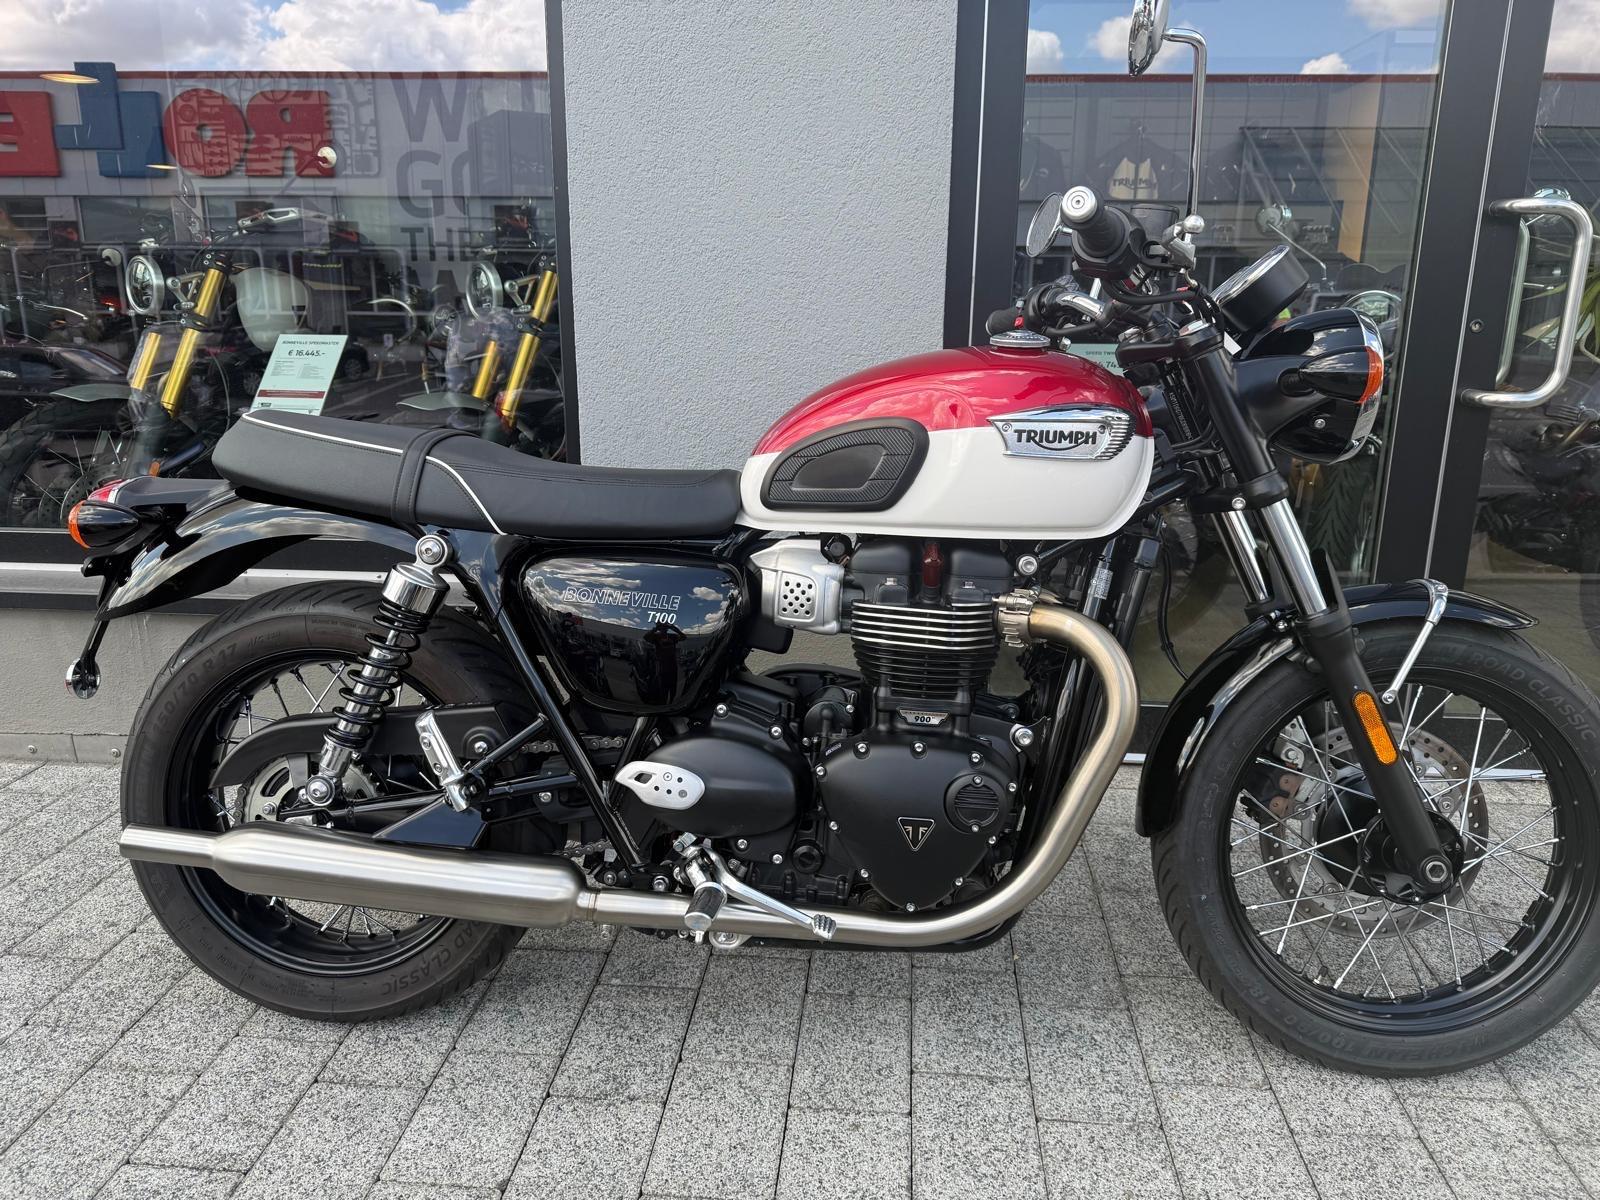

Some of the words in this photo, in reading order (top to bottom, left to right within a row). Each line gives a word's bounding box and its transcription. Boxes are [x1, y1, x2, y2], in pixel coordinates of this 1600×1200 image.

[1014, 429, 1097, 451] TRIUMPH
[563, 587, 681, 611] BONNEVILLE
[647, 611, 677, 625] T100
[1472, 653, 1526, 680] ROAD
[1528, 679, 1598, 741] CLASSIC
[382, 948, 450, 996] CLASSIC
